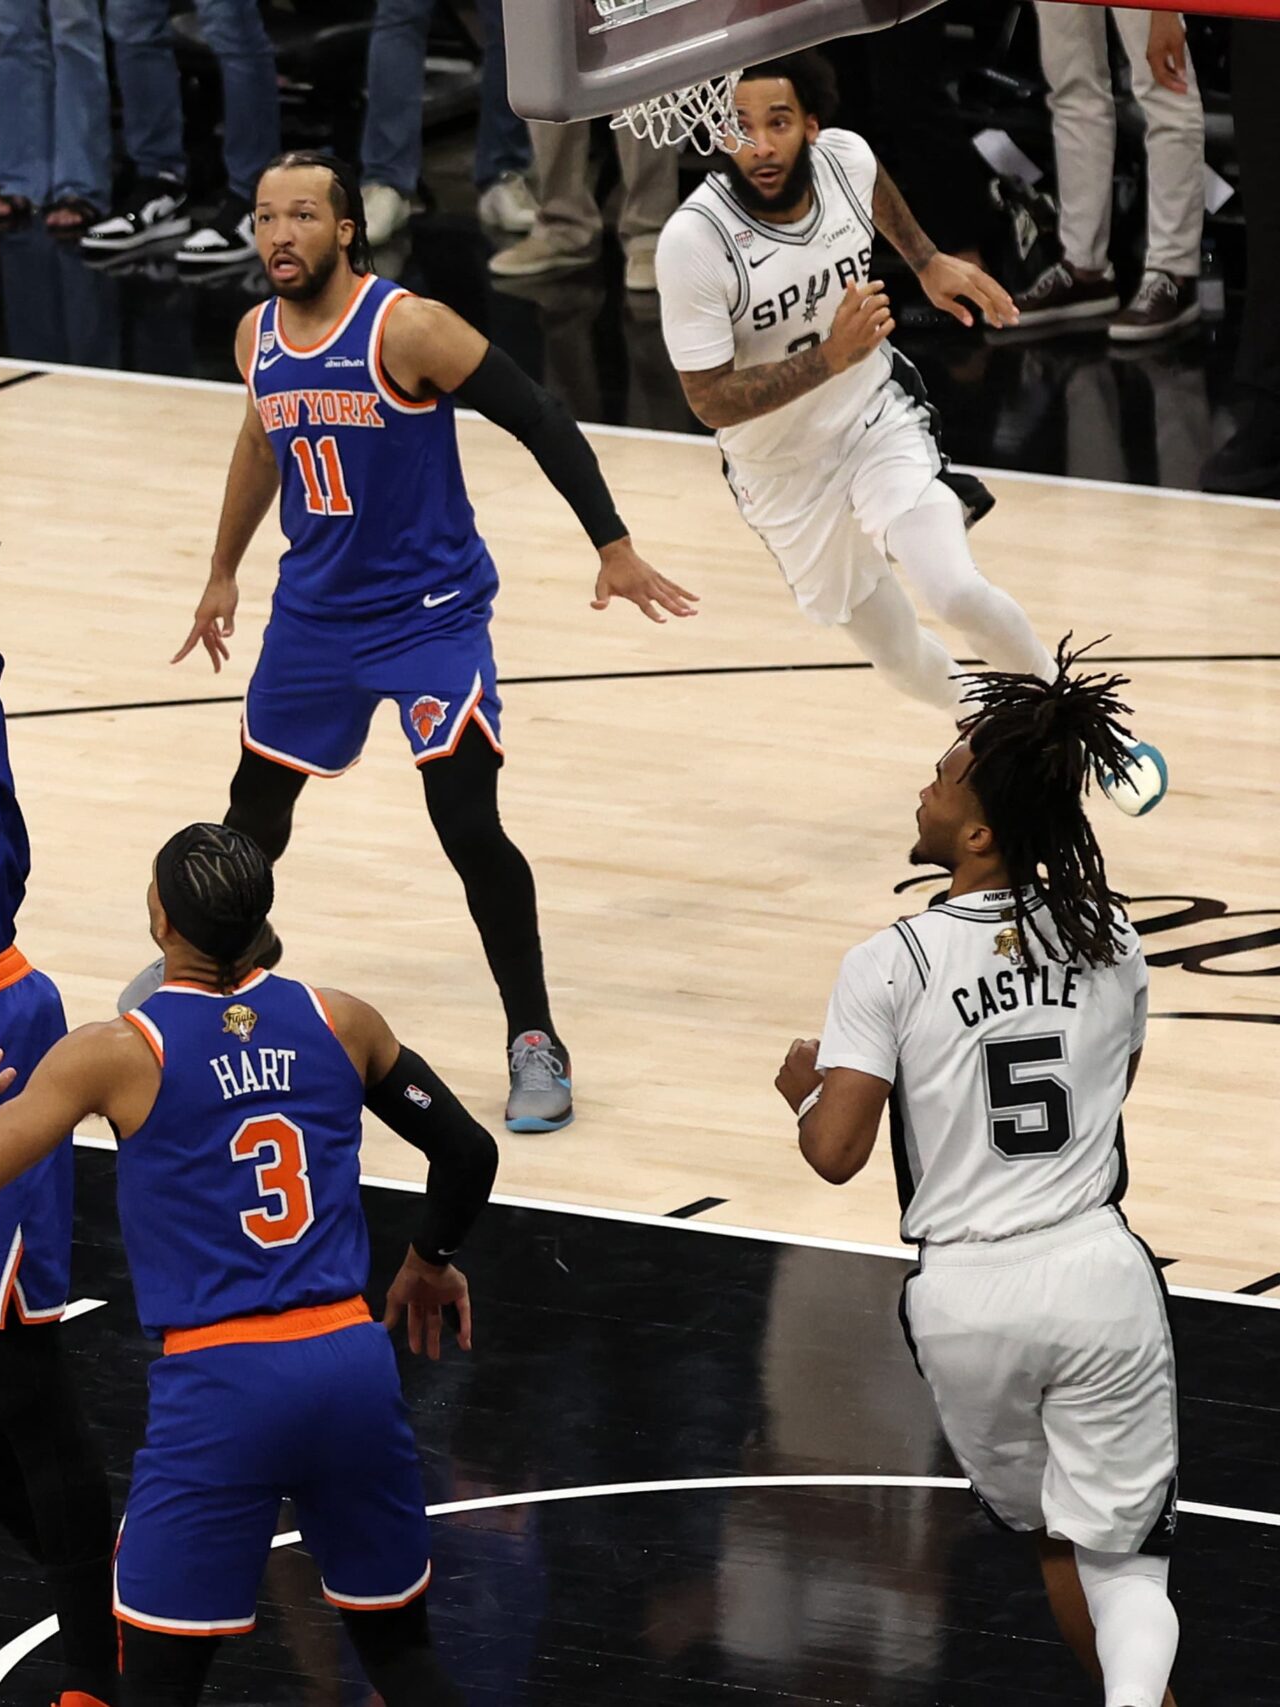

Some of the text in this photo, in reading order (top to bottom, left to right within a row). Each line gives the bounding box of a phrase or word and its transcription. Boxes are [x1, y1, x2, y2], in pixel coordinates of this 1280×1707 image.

[257, 389, 385, 434] NEW YORK
[290, 436, 354, 516] 11
[951, 965, 1082, 1028] CASTLE
[210, 1048, 296, 1100] HART
[980, 1030, 1076, 1162] 5
[229, 1112, 315, 1249] 3
